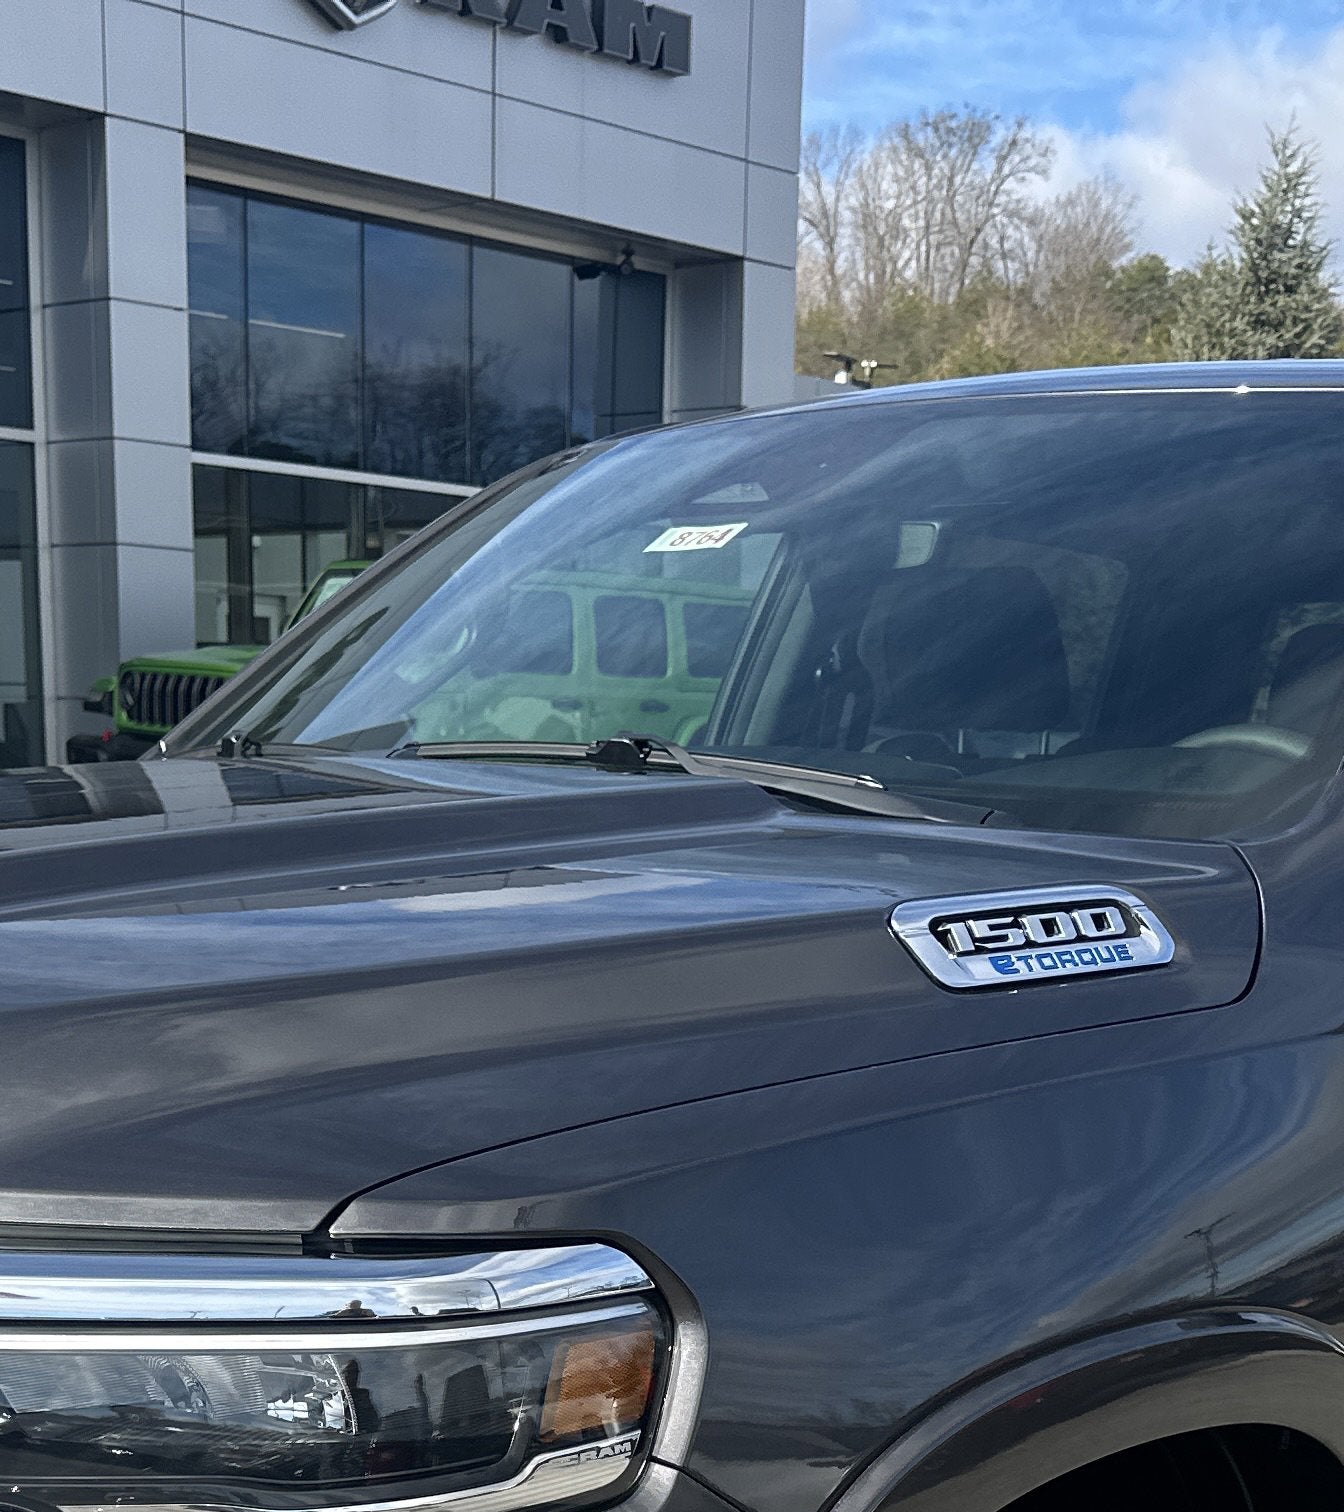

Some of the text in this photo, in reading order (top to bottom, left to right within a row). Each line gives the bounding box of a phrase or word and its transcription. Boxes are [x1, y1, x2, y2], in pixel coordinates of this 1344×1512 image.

[669, 528, 733, 547] 8764
[936, 906, 1127, 953] 1500
[579, 1441, 632, 1461] RAM
